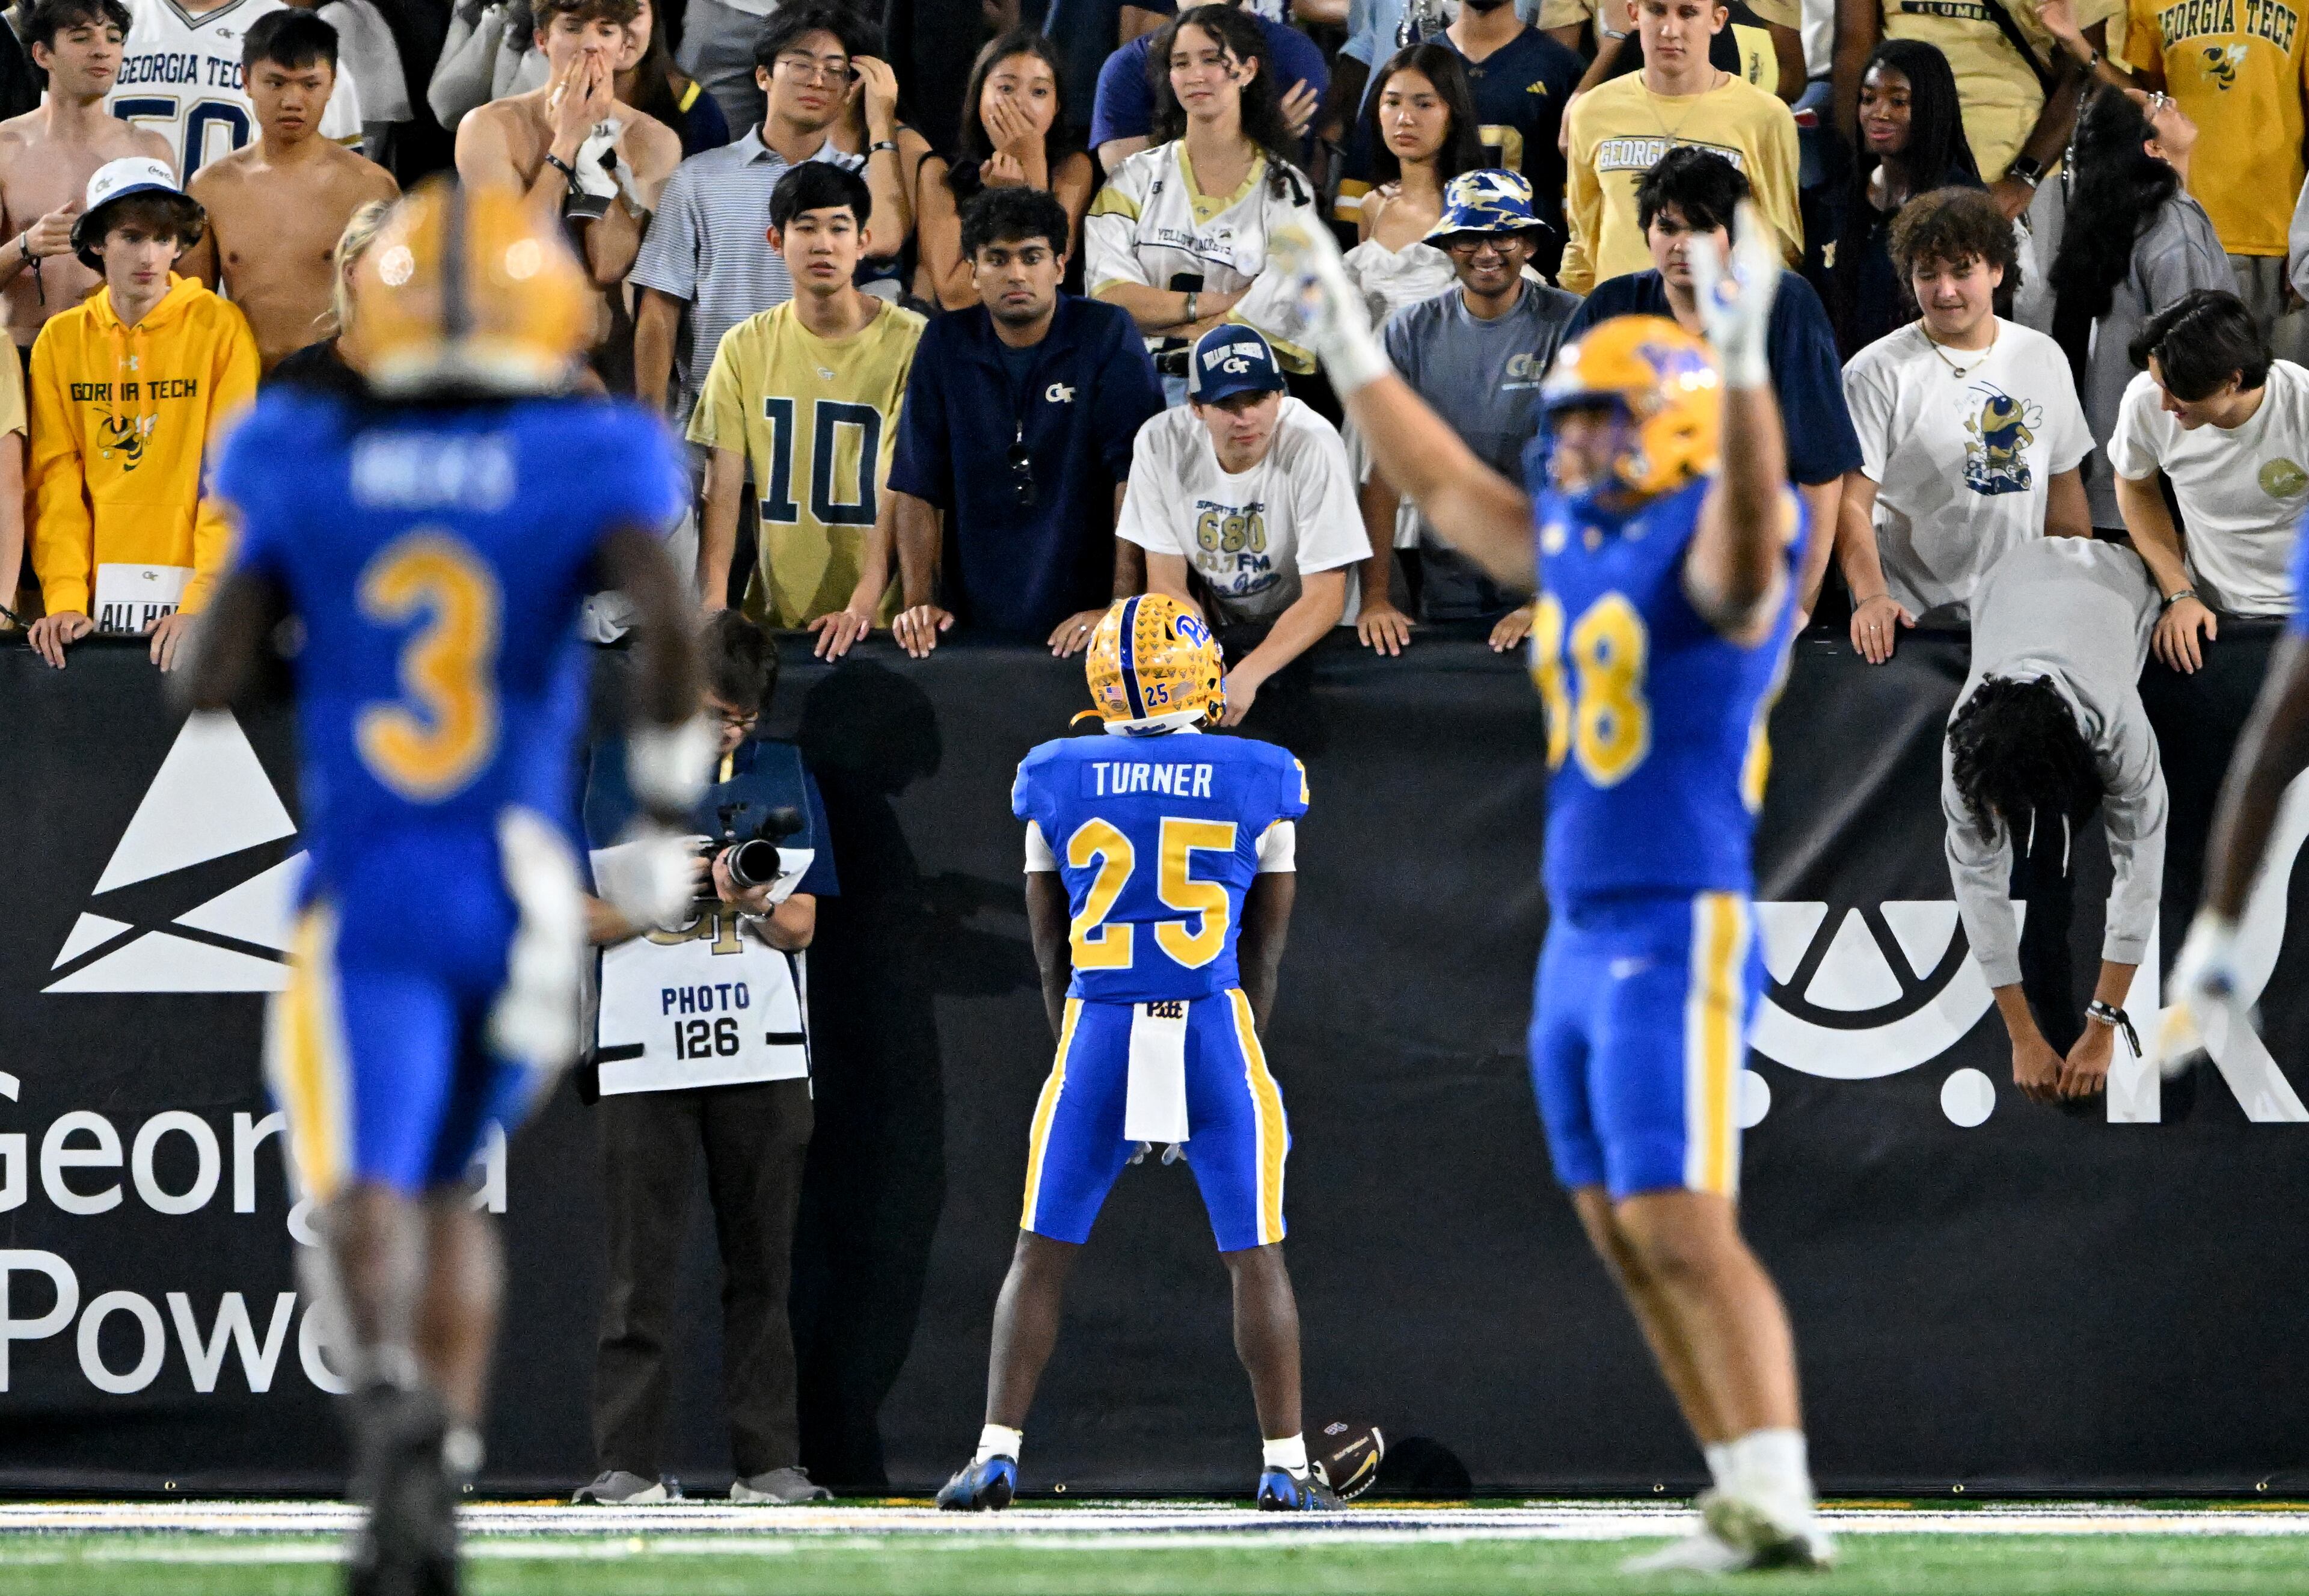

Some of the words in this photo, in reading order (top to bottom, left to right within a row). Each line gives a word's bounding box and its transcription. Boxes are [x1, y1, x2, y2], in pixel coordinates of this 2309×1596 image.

[2157, 0, 2235, 50] EORGIA
[117, 53, 198, 84] GEORGIA
[207, 56, 243, 89] TEC
[1600, 140, 1678, 167] GEORGI
[147, 379, 197, 400] TECH
[759, 396, 882, 527] 10
[1197, 511, 1266, 553] 680
[99, 603, 135, 632] ALL
[359, 530, 500, 799] 3
[1145, 683, 1168, 707] 25
[1093, 762, 1213, 797] TURNER
[1067, 816, 1237, 971] 25
[661, 981, 750, 1016] PHOTO
[1147, 1001, 1183, 1019] Pitt
[674, 1017, 740, 1061] 126
[0, 1248, 356, 1395] Pow
